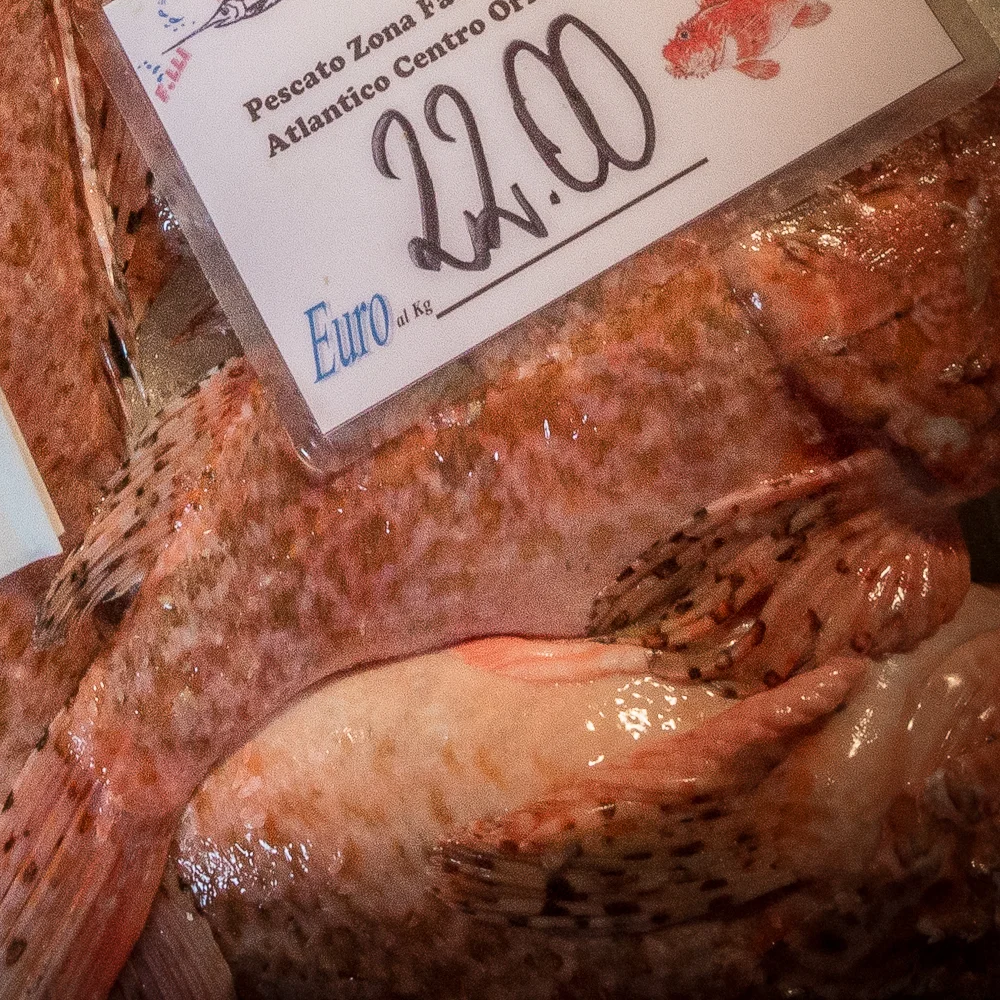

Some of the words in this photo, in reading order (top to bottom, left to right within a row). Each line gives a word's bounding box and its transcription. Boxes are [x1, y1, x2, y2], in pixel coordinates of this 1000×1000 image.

[242, 55, 347, 123] Pescato
[345, 13, 418, 62] Zona
[266, 75, 392, 159] Atlantico
[392, 18, 487, 79] Centro
[371, 13, 656, 271] 22.00
[303, 292, 390, 384] Euro
[397, 308, 410, 328] al
[411, 299, 434, 319] Kg
